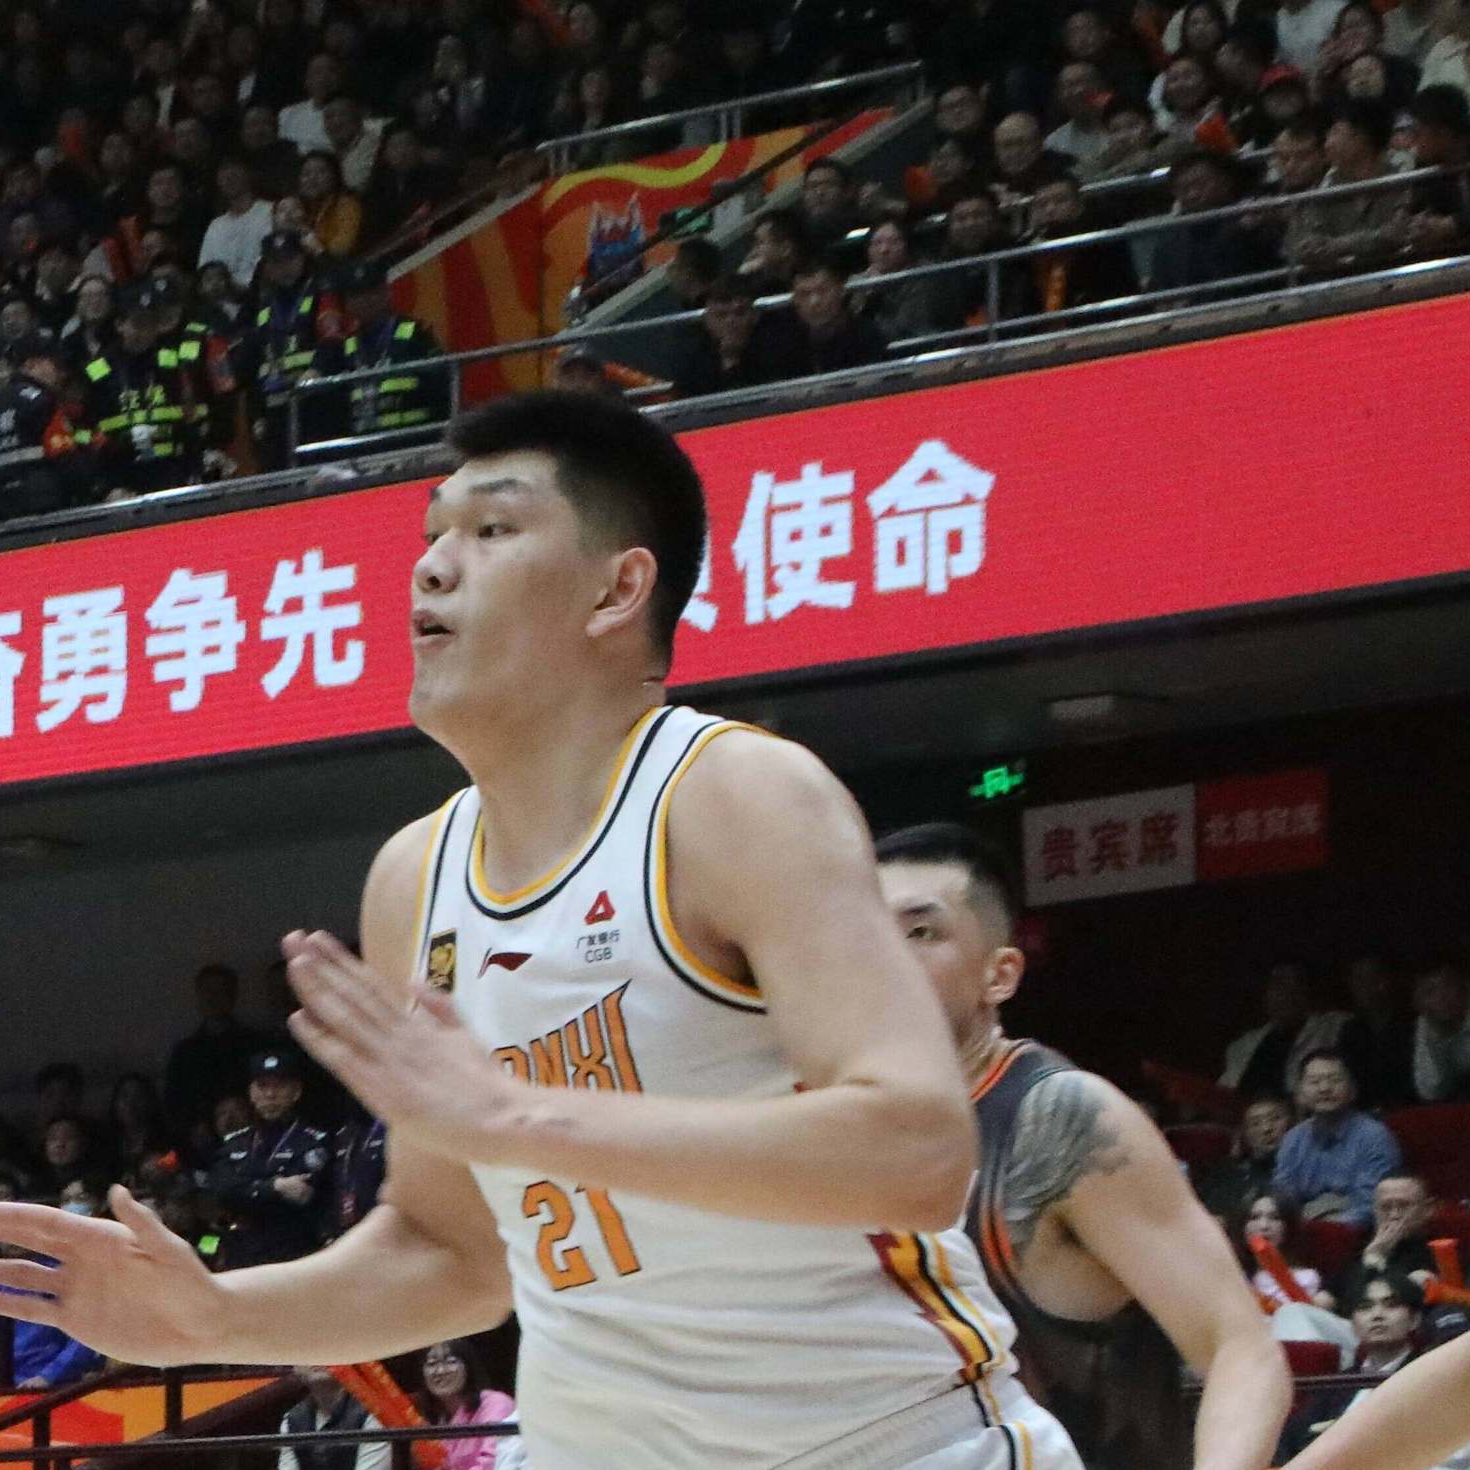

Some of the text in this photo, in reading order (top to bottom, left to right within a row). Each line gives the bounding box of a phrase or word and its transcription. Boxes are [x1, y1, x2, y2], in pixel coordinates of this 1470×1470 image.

[679, 440, 995, 632] 使命
[583, 949, 614, 965] CGB
[521, 1180, 642, 1292] 21
